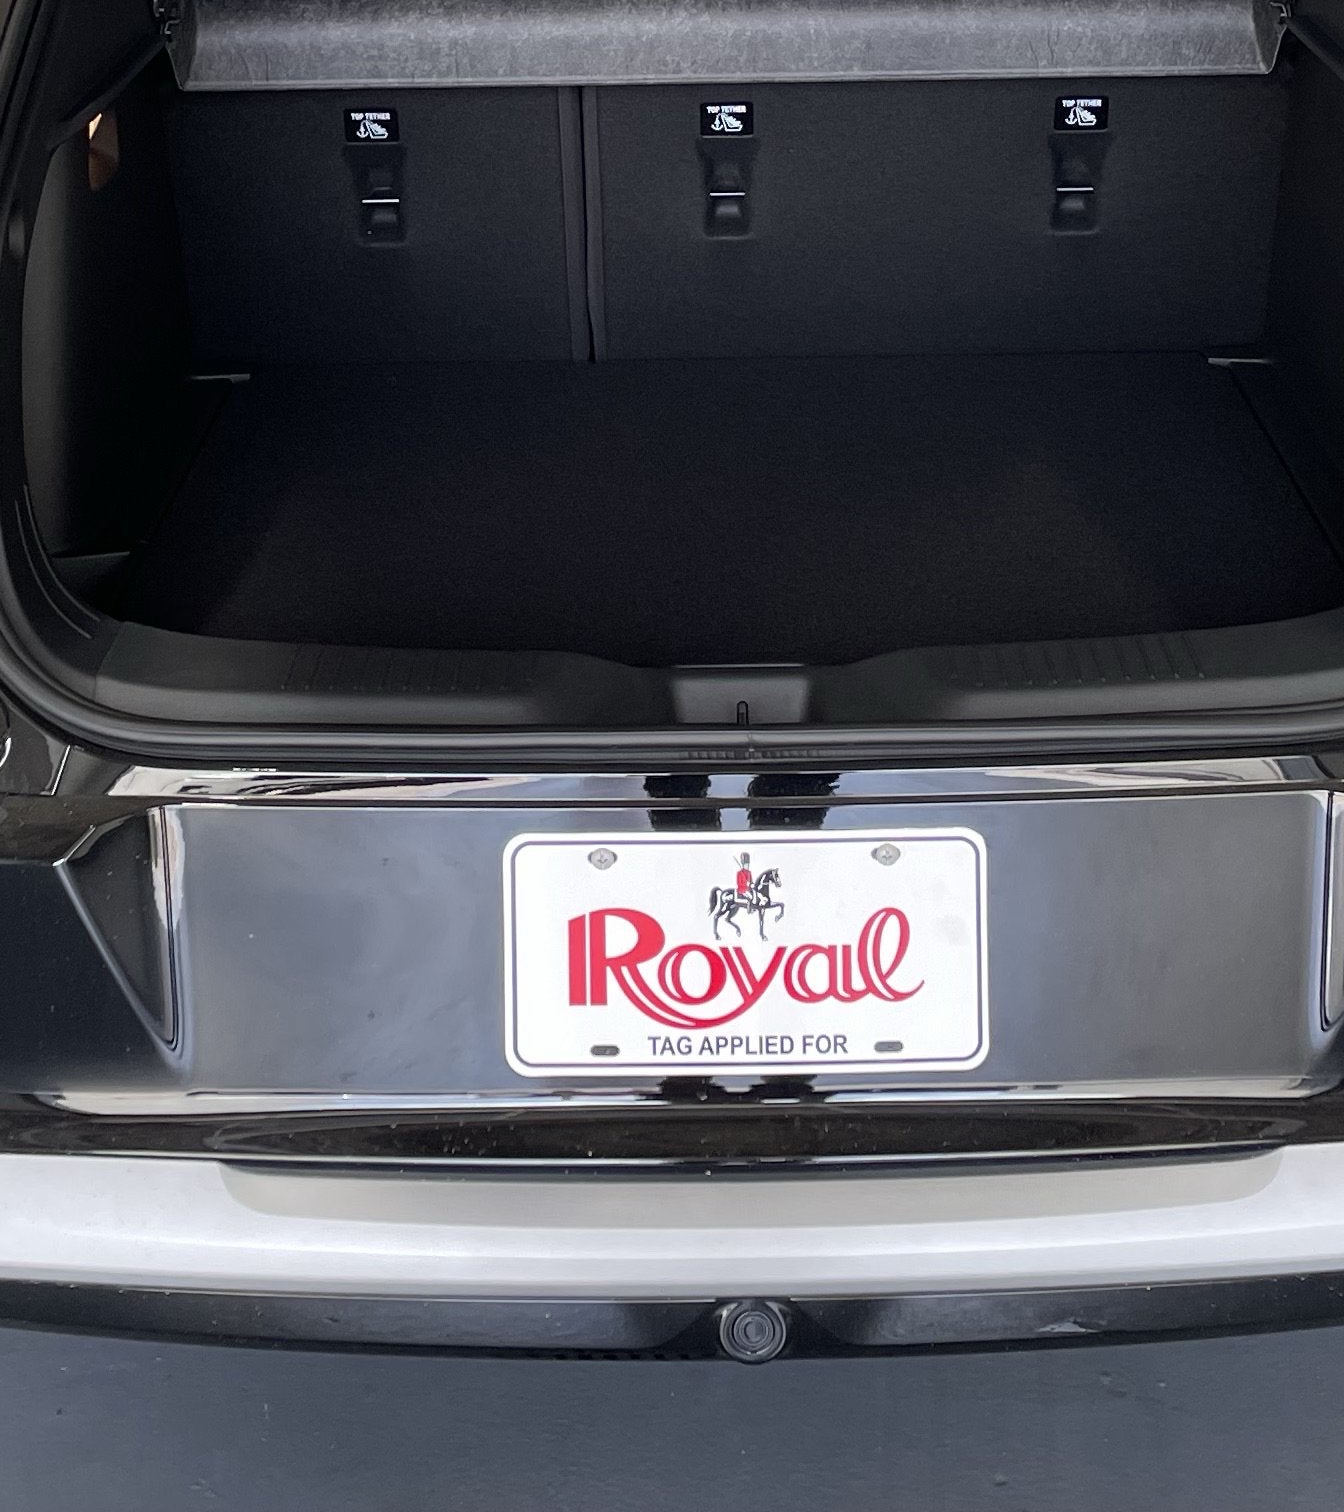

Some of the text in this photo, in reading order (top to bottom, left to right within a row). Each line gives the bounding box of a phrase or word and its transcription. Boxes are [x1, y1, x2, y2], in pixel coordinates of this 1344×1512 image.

[568, 907, 925, 1030] Royal
[647, 1034, 849, 1056] TAG APPLIED FOR
